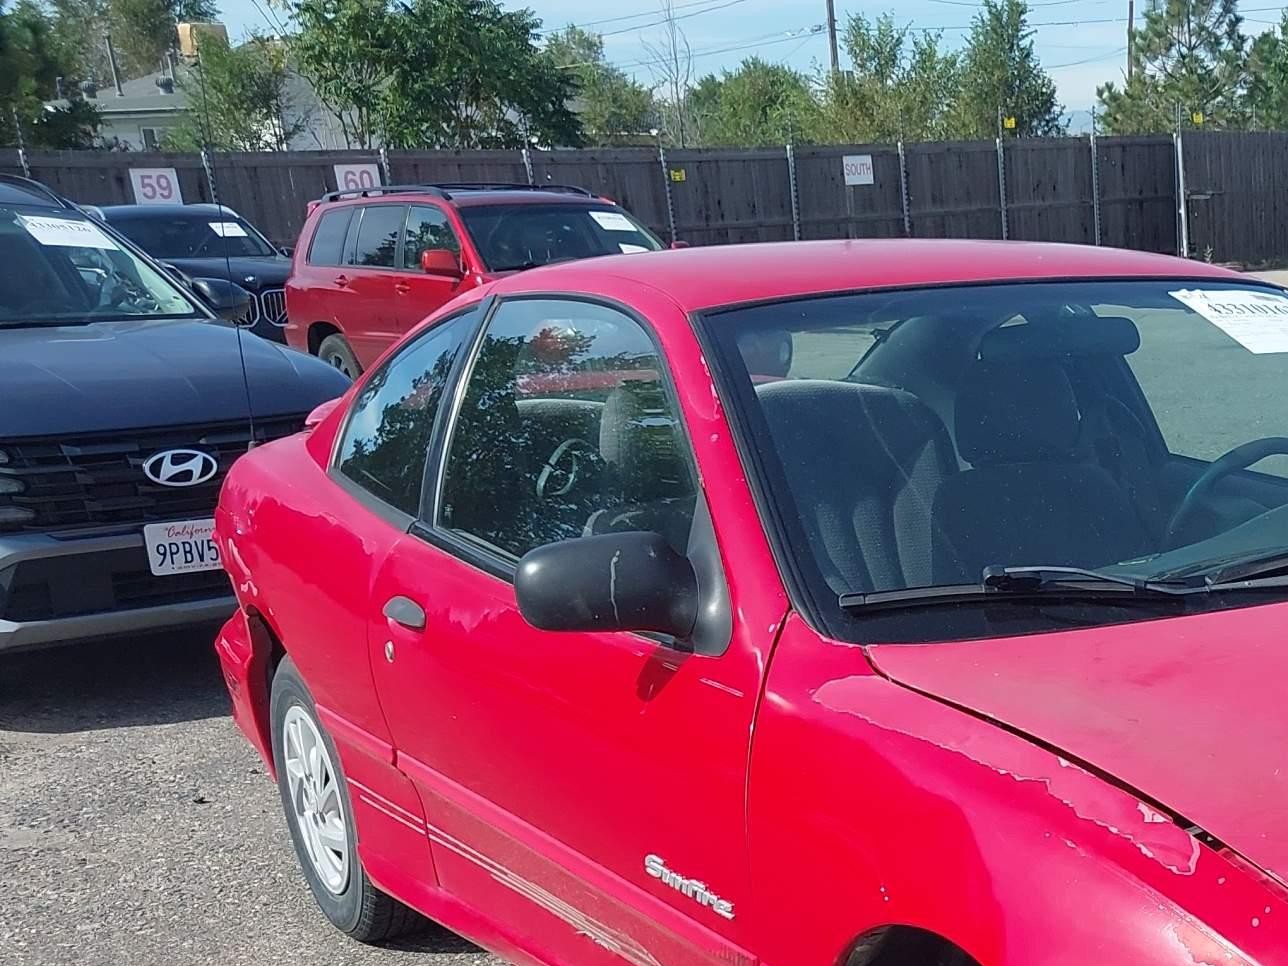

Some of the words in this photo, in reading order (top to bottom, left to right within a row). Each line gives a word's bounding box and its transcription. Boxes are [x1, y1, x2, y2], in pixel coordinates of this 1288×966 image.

[344, 169, 374, 189] 60
[845, 163, 872, 176] SOUTH
[141, 174, 172, 200] 59
[644, 853, 735, 920] Sunfire
